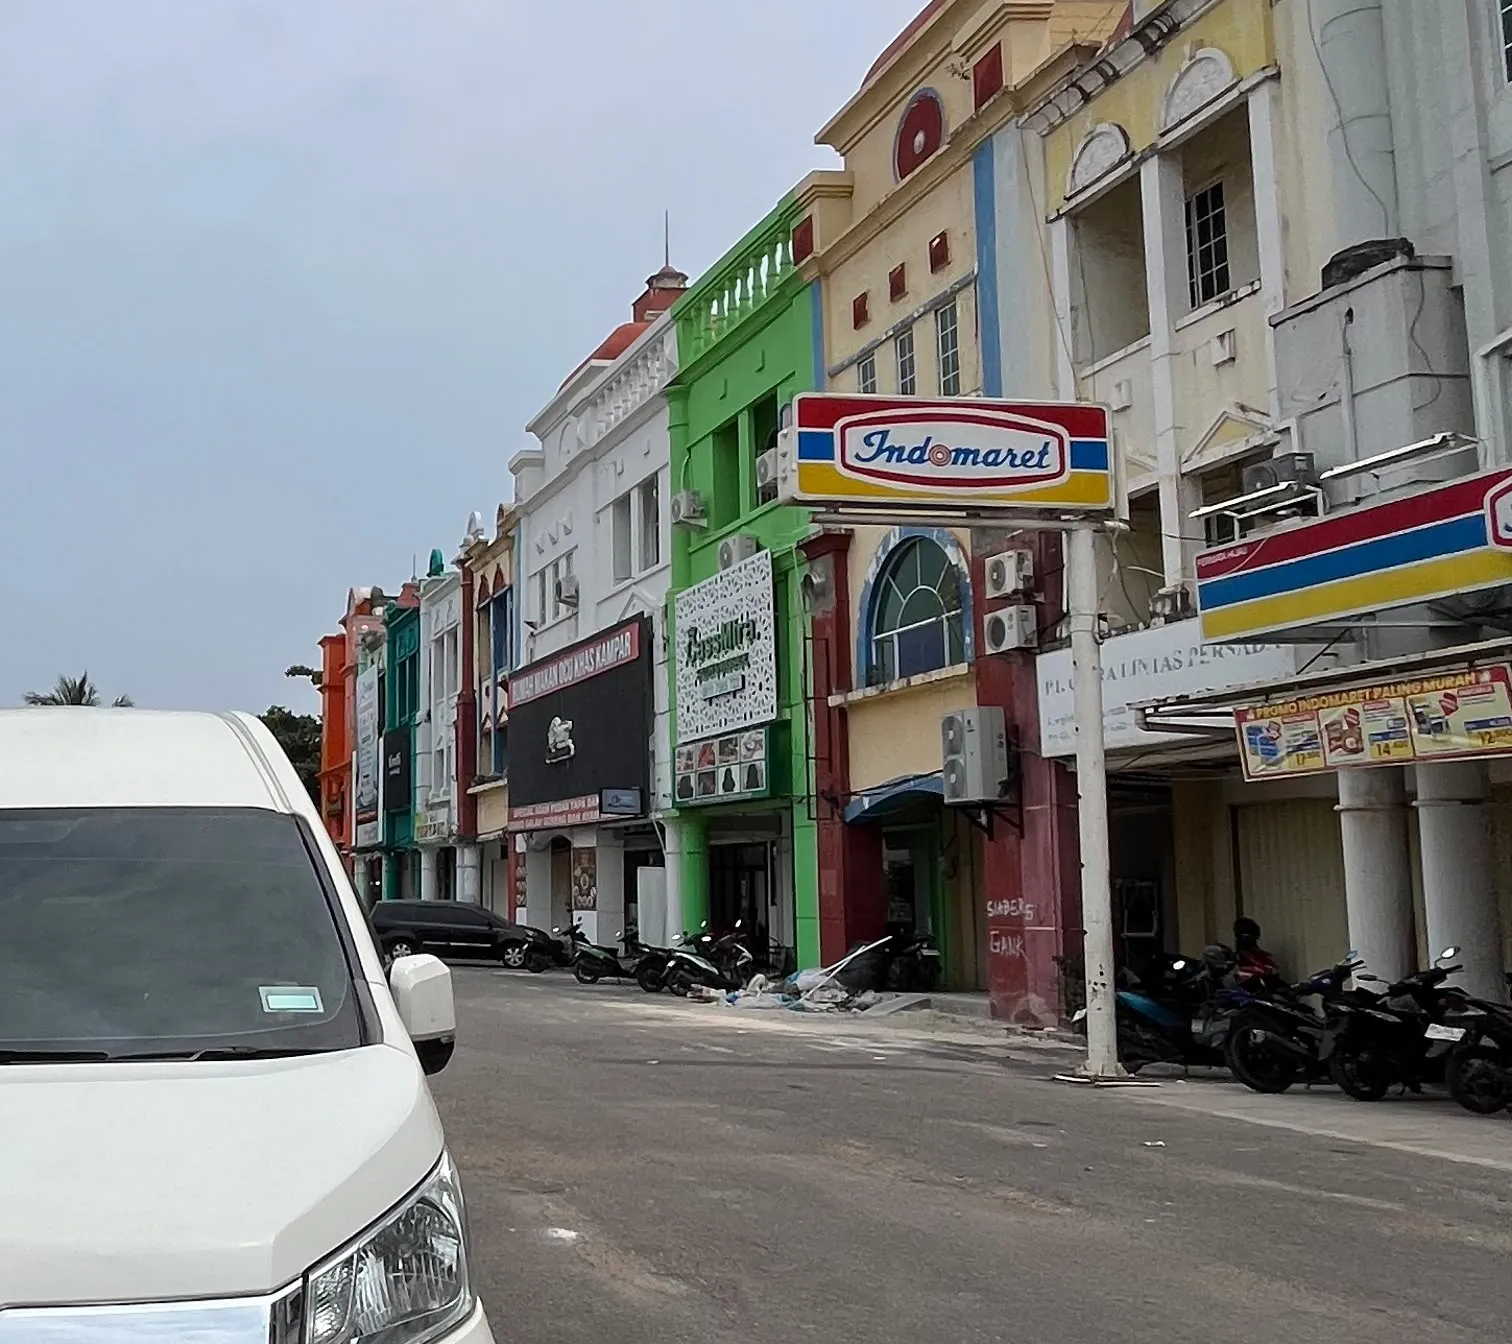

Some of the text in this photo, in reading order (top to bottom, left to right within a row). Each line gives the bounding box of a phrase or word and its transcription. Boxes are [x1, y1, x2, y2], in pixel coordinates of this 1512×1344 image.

[854, 428, 1052, 470] Indomaret
[595, 631, 631, 670] KAMPAR
[1255, 701, 1298, 719] PROMO
[1299, 688, 1372, 714] INDOMARET
[1422, 670, 1476, 692] MURAH
